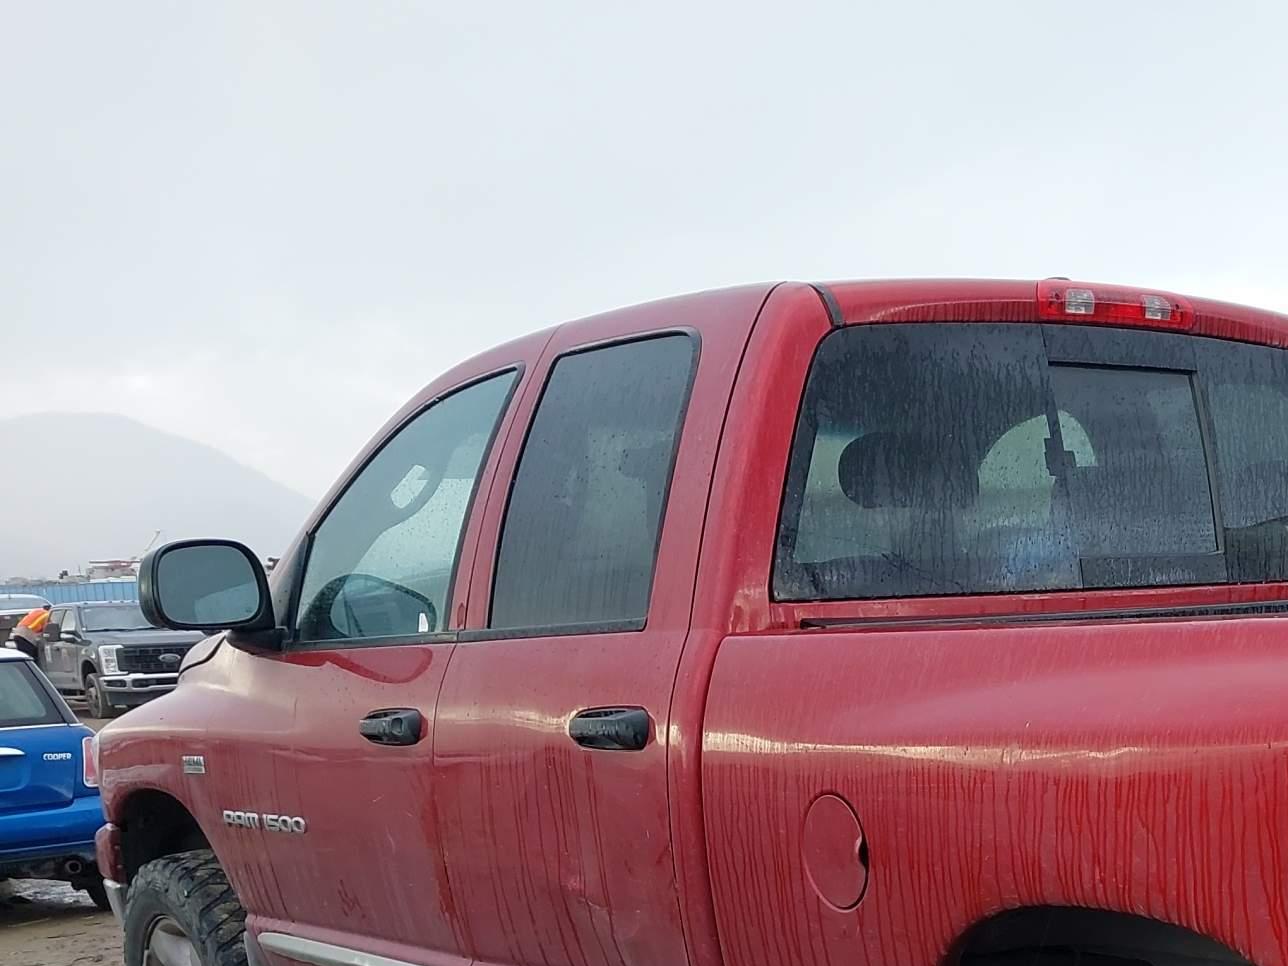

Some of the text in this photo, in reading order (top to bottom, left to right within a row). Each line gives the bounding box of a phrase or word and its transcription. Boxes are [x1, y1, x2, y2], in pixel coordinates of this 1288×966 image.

[42, 752, 72, 761] COOPER
[223, 810, 306, 833] RAM 1500
